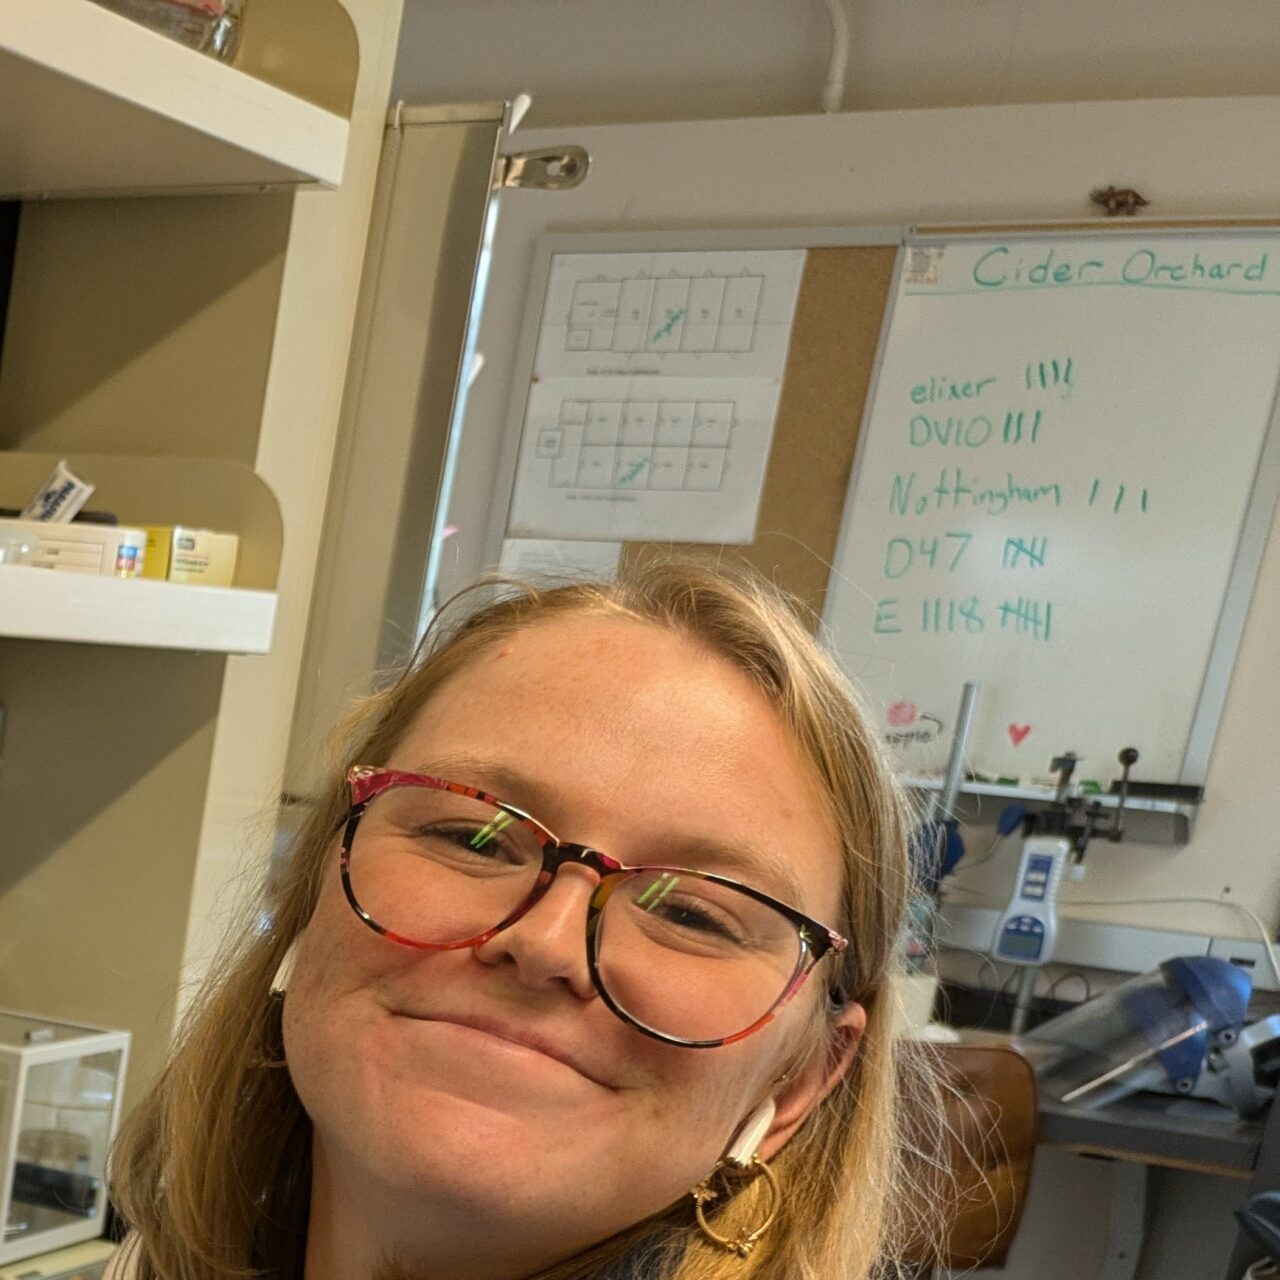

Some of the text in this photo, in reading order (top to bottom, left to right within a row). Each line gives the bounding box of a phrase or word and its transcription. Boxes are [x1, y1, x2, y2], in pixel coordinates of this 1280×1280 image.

[973, 246, 1267, 286] Cider Orchard
[888, 467, 1061, 516] Nottingham
[885, 532, 972, 579] D47
